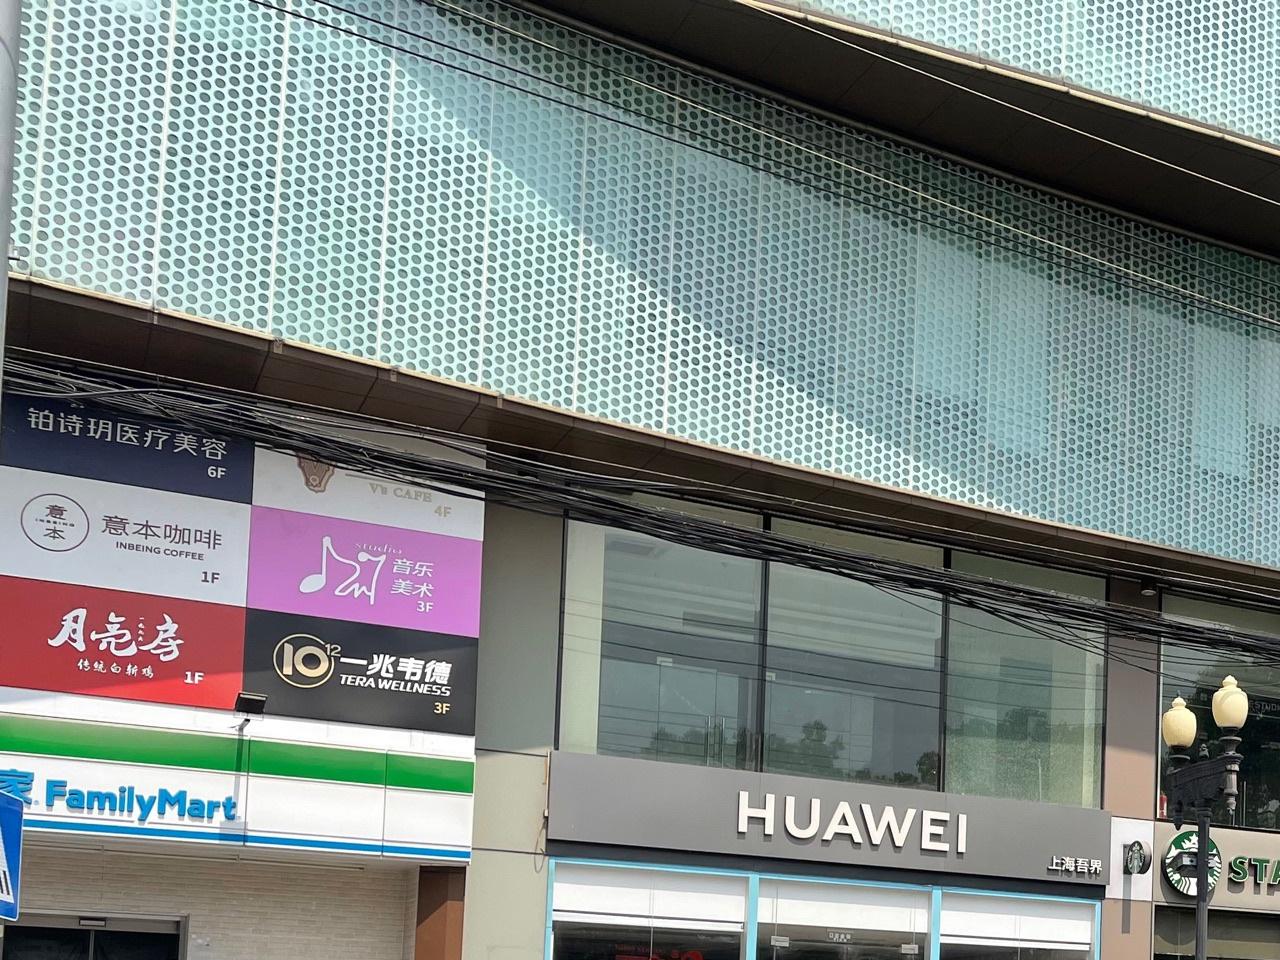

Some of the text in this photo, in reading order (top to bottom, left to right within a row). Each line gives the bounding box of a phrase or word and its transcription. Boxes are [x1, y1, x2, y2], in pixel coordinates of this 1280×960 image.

[27, 408, 228, 460] 铂诗玥医疗美容
[208, 466, 227, 478] 6F
[393, 487, 433, 503] CAFE
[434, 505, 452, 518] 4F
[102, 515, 222, 550] 意本咖啡
[116, 541, 205, 561] INBEING COFFEE
[201, 571, 220, 584] 1F
[392, 558, 434, 578] 音乐
[390, 579, 435, 598] 美术
[416, 601, 433, 613] 3F
[47, 608, 185, 662] 月亮房
[77, 658, 154, 679] 传统白斩鸡
[184, 671, 204, 685] 1F
[340, 653, 452, 685] 一兆韦德
[340, 674, 451, 697] TERA WELLNESS
[433, 702, 450, 714] 3F
[45, 779, 237, 822] FamilyMart
[737, 790, 967, 854] HUAWEI
[1049, 856, 1103, 873] 上海吾界
